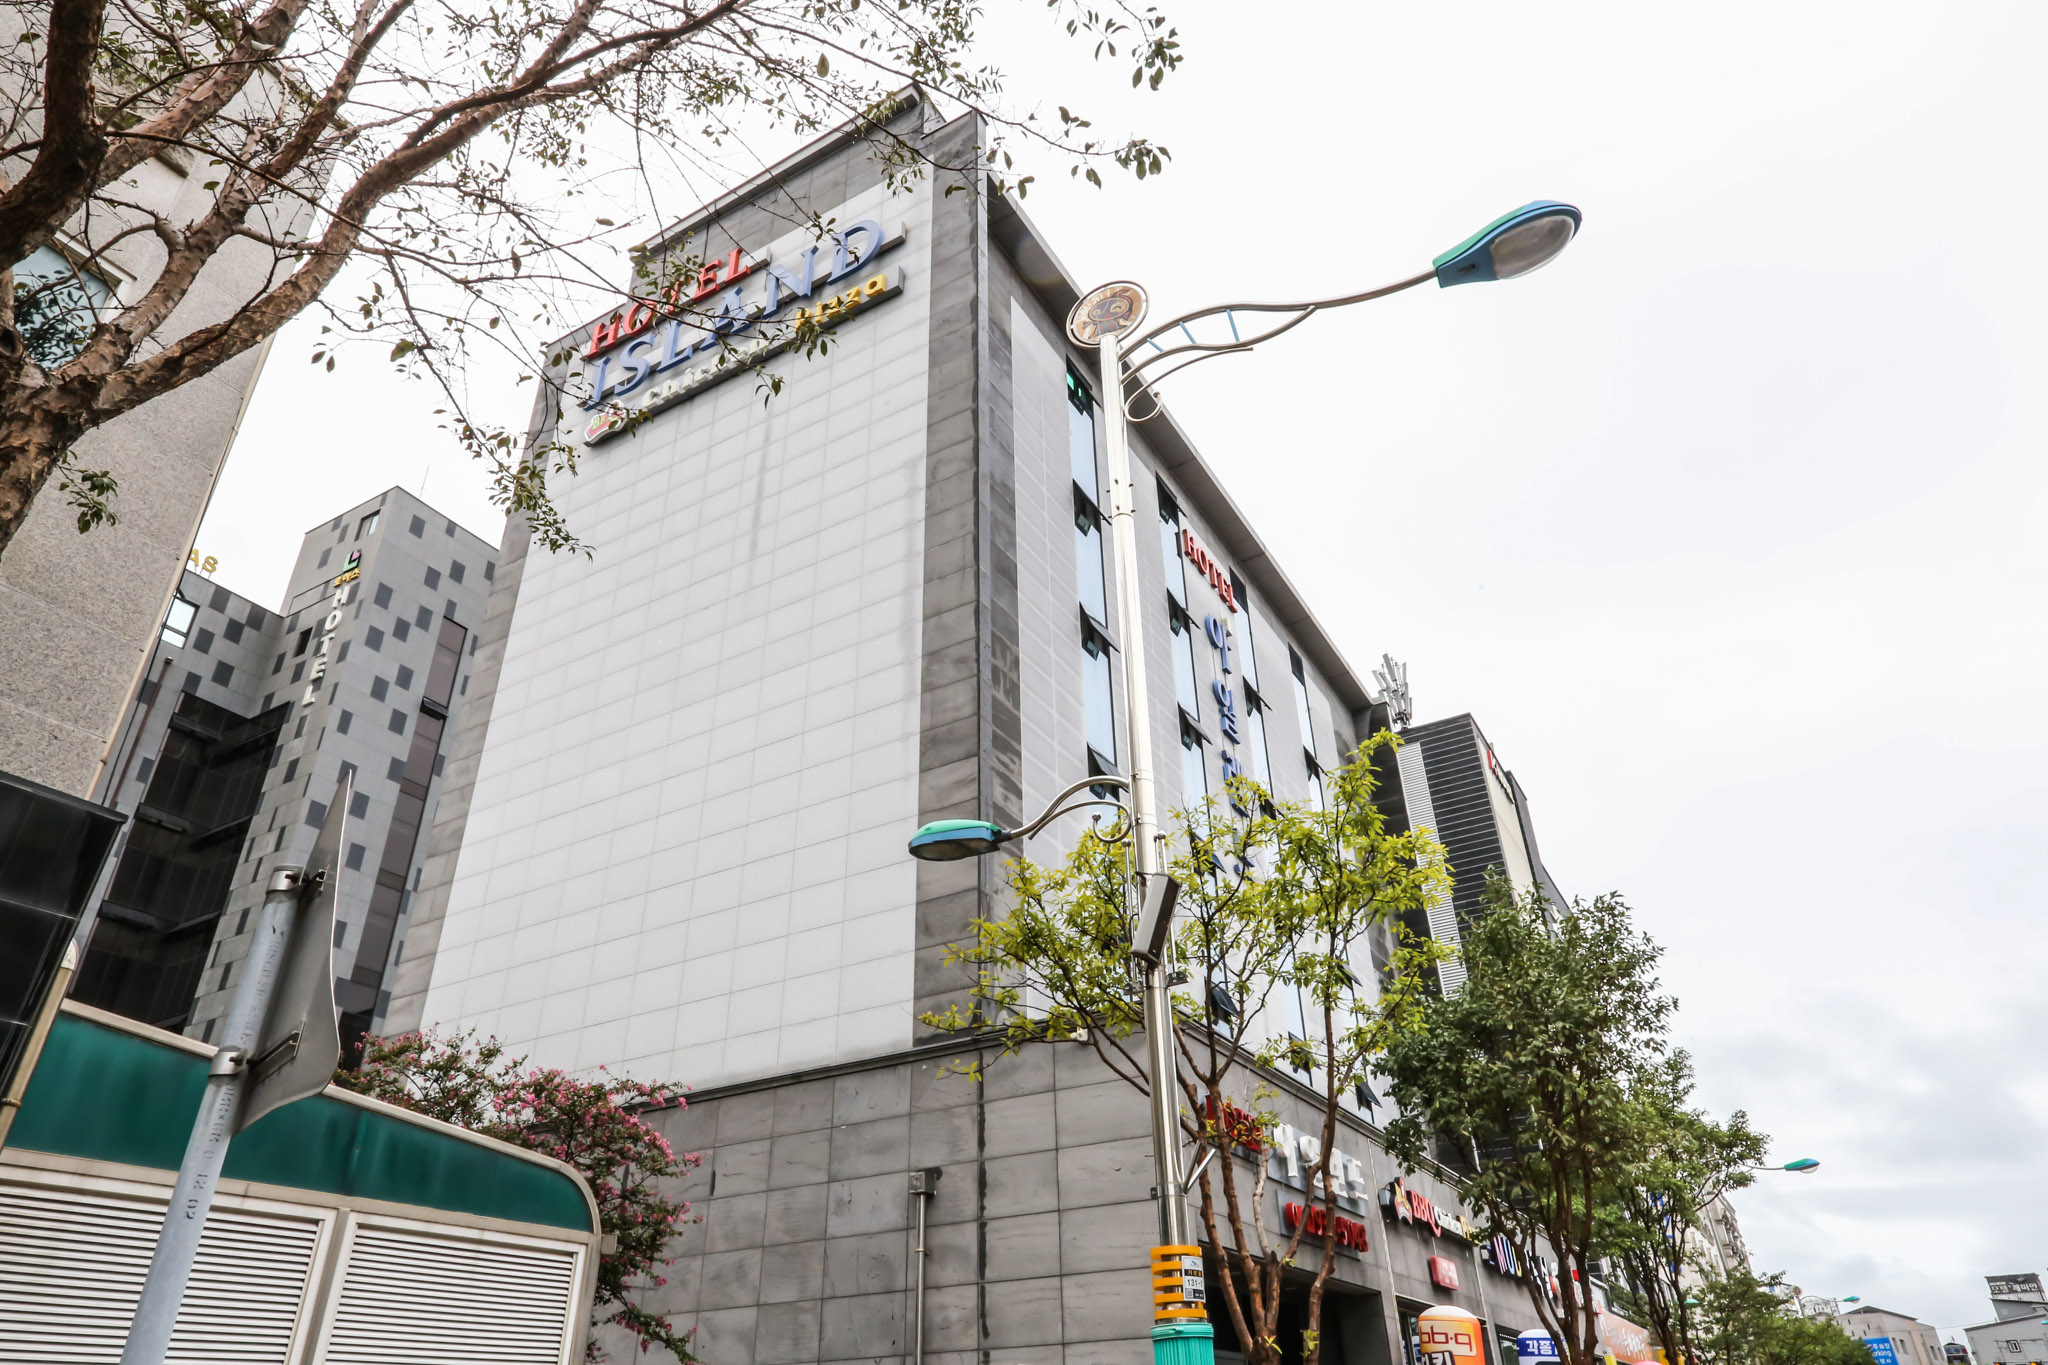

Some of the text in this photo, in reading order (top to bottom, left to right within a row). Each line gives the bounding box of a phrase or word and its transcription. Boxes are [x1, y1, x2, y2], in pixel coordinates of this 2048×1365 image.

[584, 219, 884, 411] ISLAND
[1183, 529, 1238, 613] HOTEL
[301, 585, 350, 707] HOTEL
[1411, 1190, 1442, 1238] BBQ
